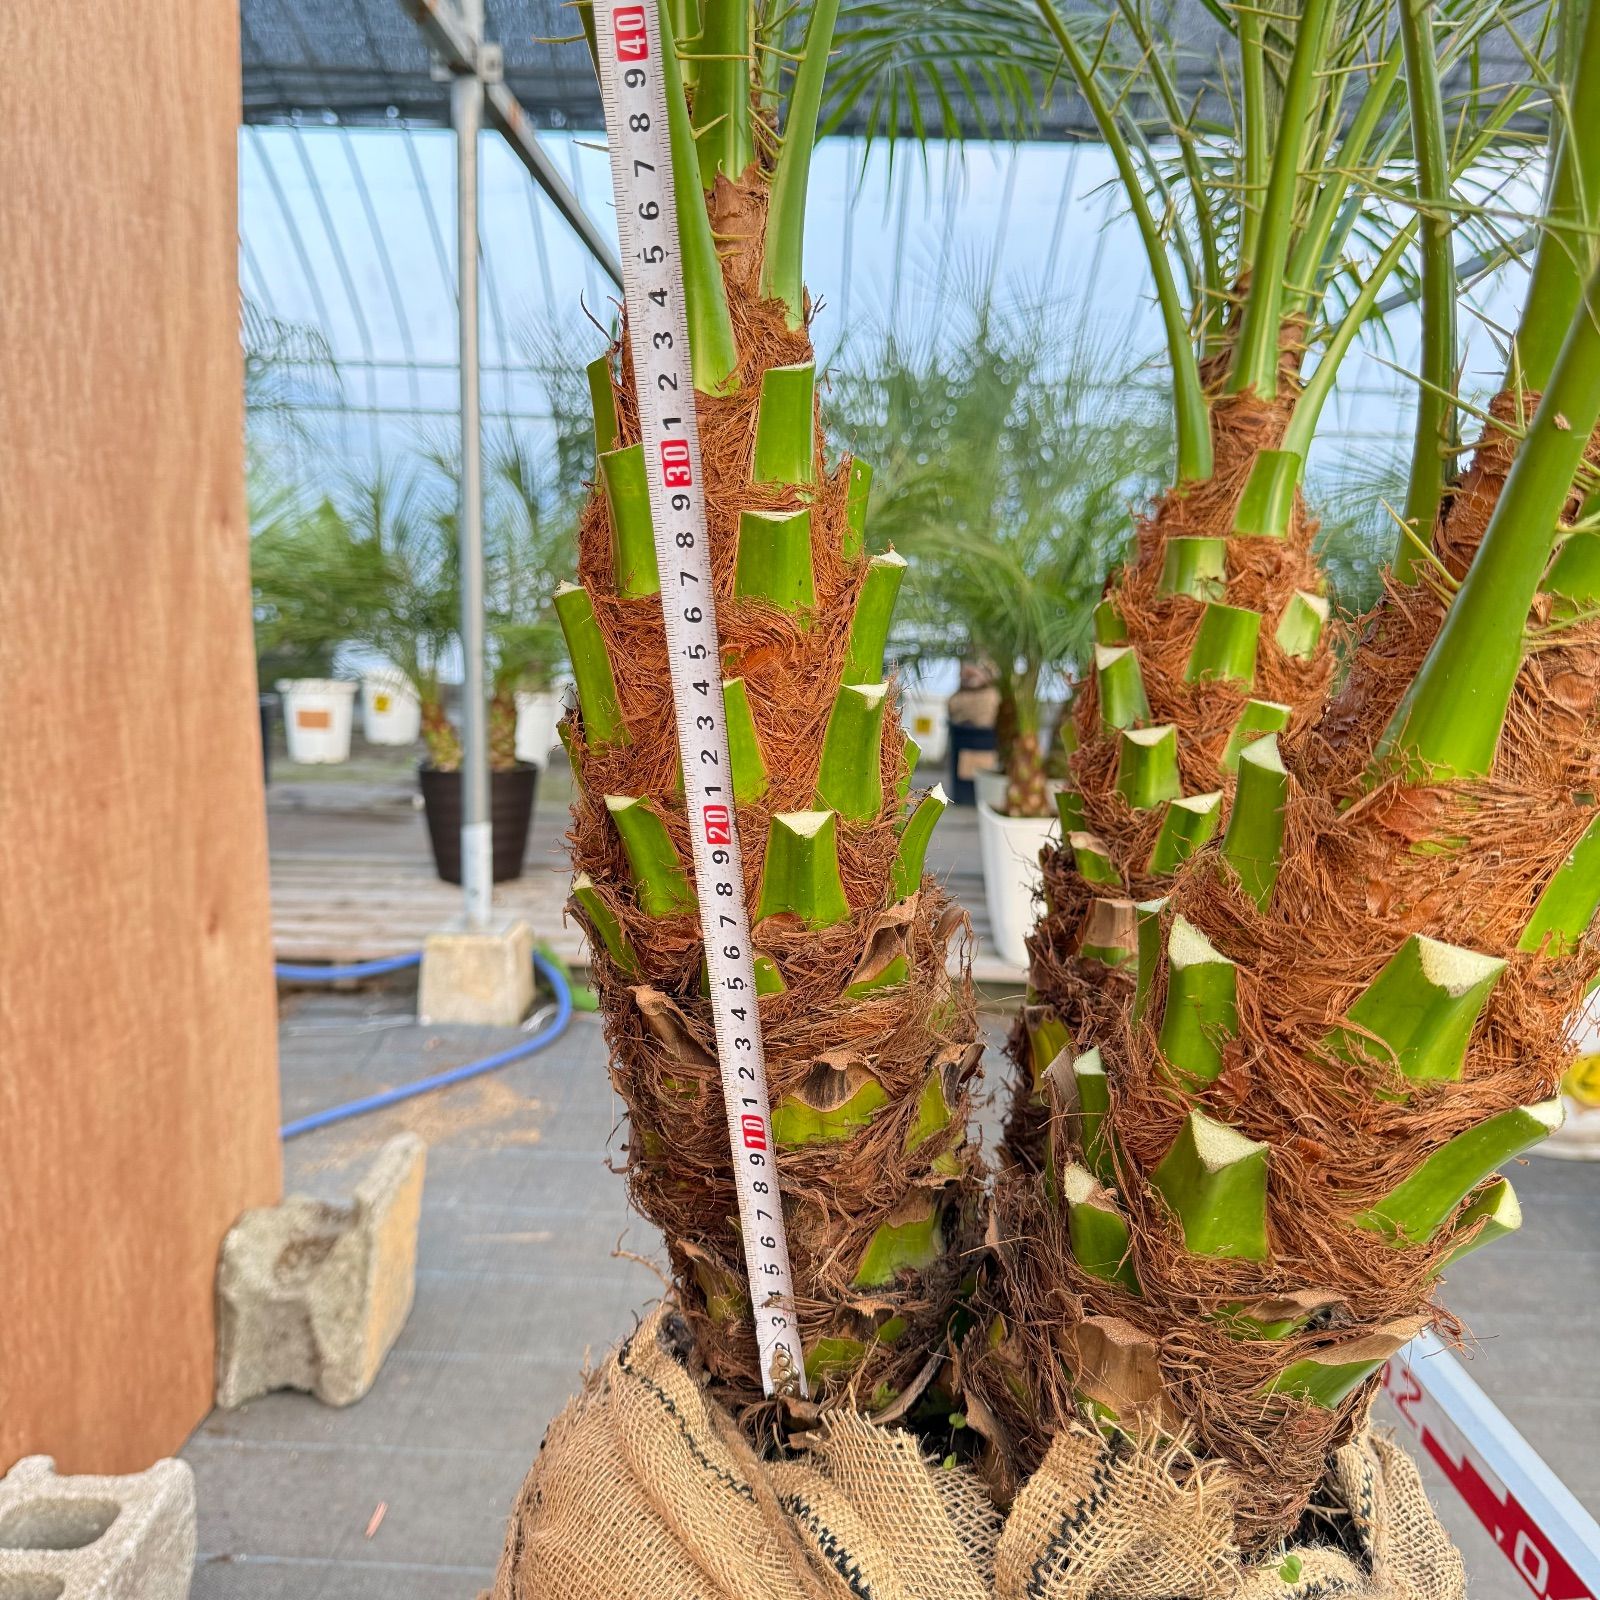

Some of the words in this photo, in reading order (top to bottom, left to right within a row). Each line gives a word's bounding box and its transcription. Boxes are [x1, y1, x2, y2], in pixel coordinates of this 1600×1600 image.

[616, 13, 646, 55] 40
[624, 68, 647, 89] 9
[629, 112, 651, 132] 8
[634, 160, 655, 177] 7
[639, 201, 660, 220] 6
[643, 245, 664, 264] 5
[648, 288, 668, 307] 4
[653, 331, 673, 350] 3
[657, 373, 678, 391] 2
[662, 417, 682, 430] 1
[663, 445, 692, 481] 30
[671, 494, 691, 511] 9
[676, 532, 694, 548] 8
[680, 571, 698, 586] 7
[684, 606, 702, 623] 6
[688, 644, 707, 660] 5
[693, 679, 710, 696] 4
[697, 715, 714, 731] 3
[701, 750, 719, 765] 2
[705, 786, 721, 797] 1
[706, 810, 732, 844] 20
[712, 850, 730, 864] 9
[716, 882, 733, 896] 8
[719, 915, 737, 928] 7
[723, 945, 741, 960] 6
[727, 976, 744, 991] 5
[731, 1007, 748, 1021] 4
[735, 1037, 752, 1051] 3
[738, 1066, 755, 1081] 2
[742, 1098, 758, 1107] 1
[743, 1118, 766, 1147] 10
[750, 1153, 765, 1166] 9
[753, 1181, 769, 1194] 8
[757, 1209, 773, 1220] 7
[760, 1235, 776, 1249] 6
[764, 1263, 780, 1276] 5
[772, 1316, 786, 1328] 3
